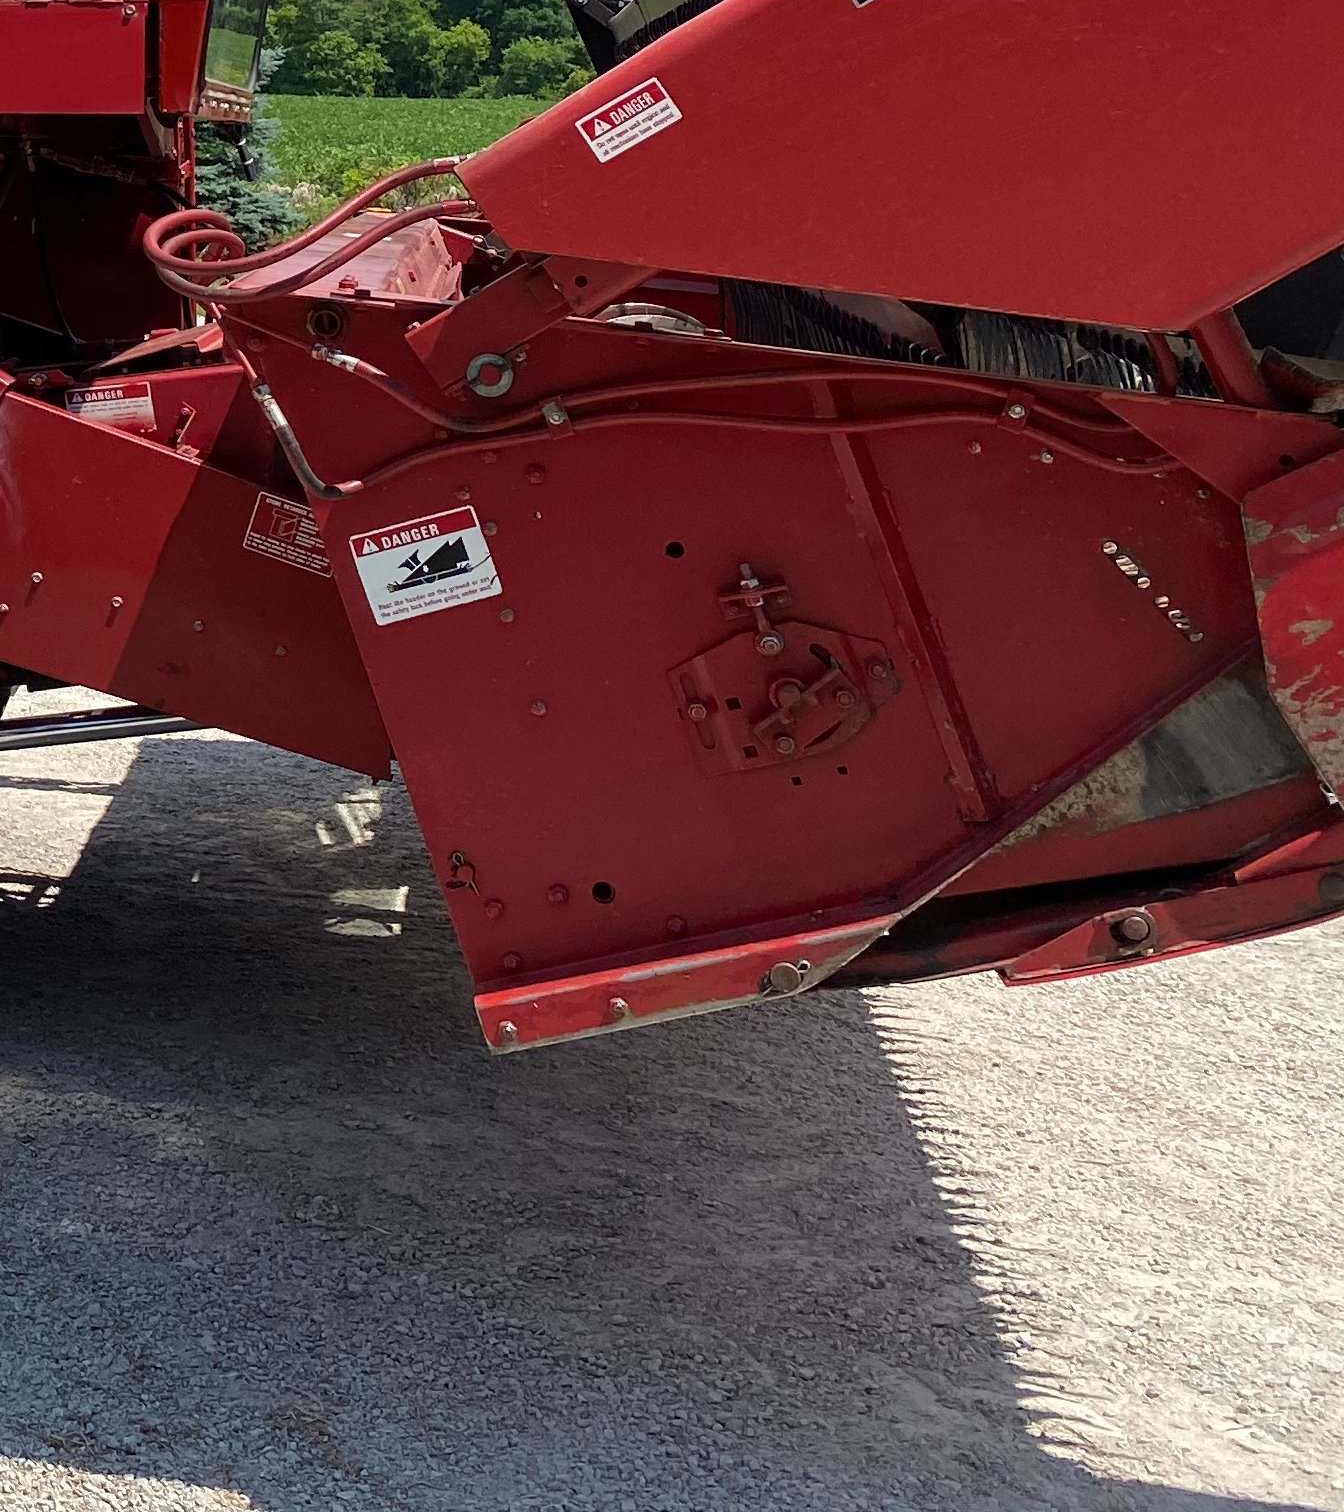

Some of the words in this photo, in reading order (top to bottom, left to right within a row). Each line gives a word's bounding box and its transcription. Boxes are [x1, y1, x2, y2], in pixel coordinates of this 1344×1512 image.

[609, 92, 656, 124] DANGER
[84, 390, 124, 402] DANGER
[381, 524, 440, 550] DANGER
